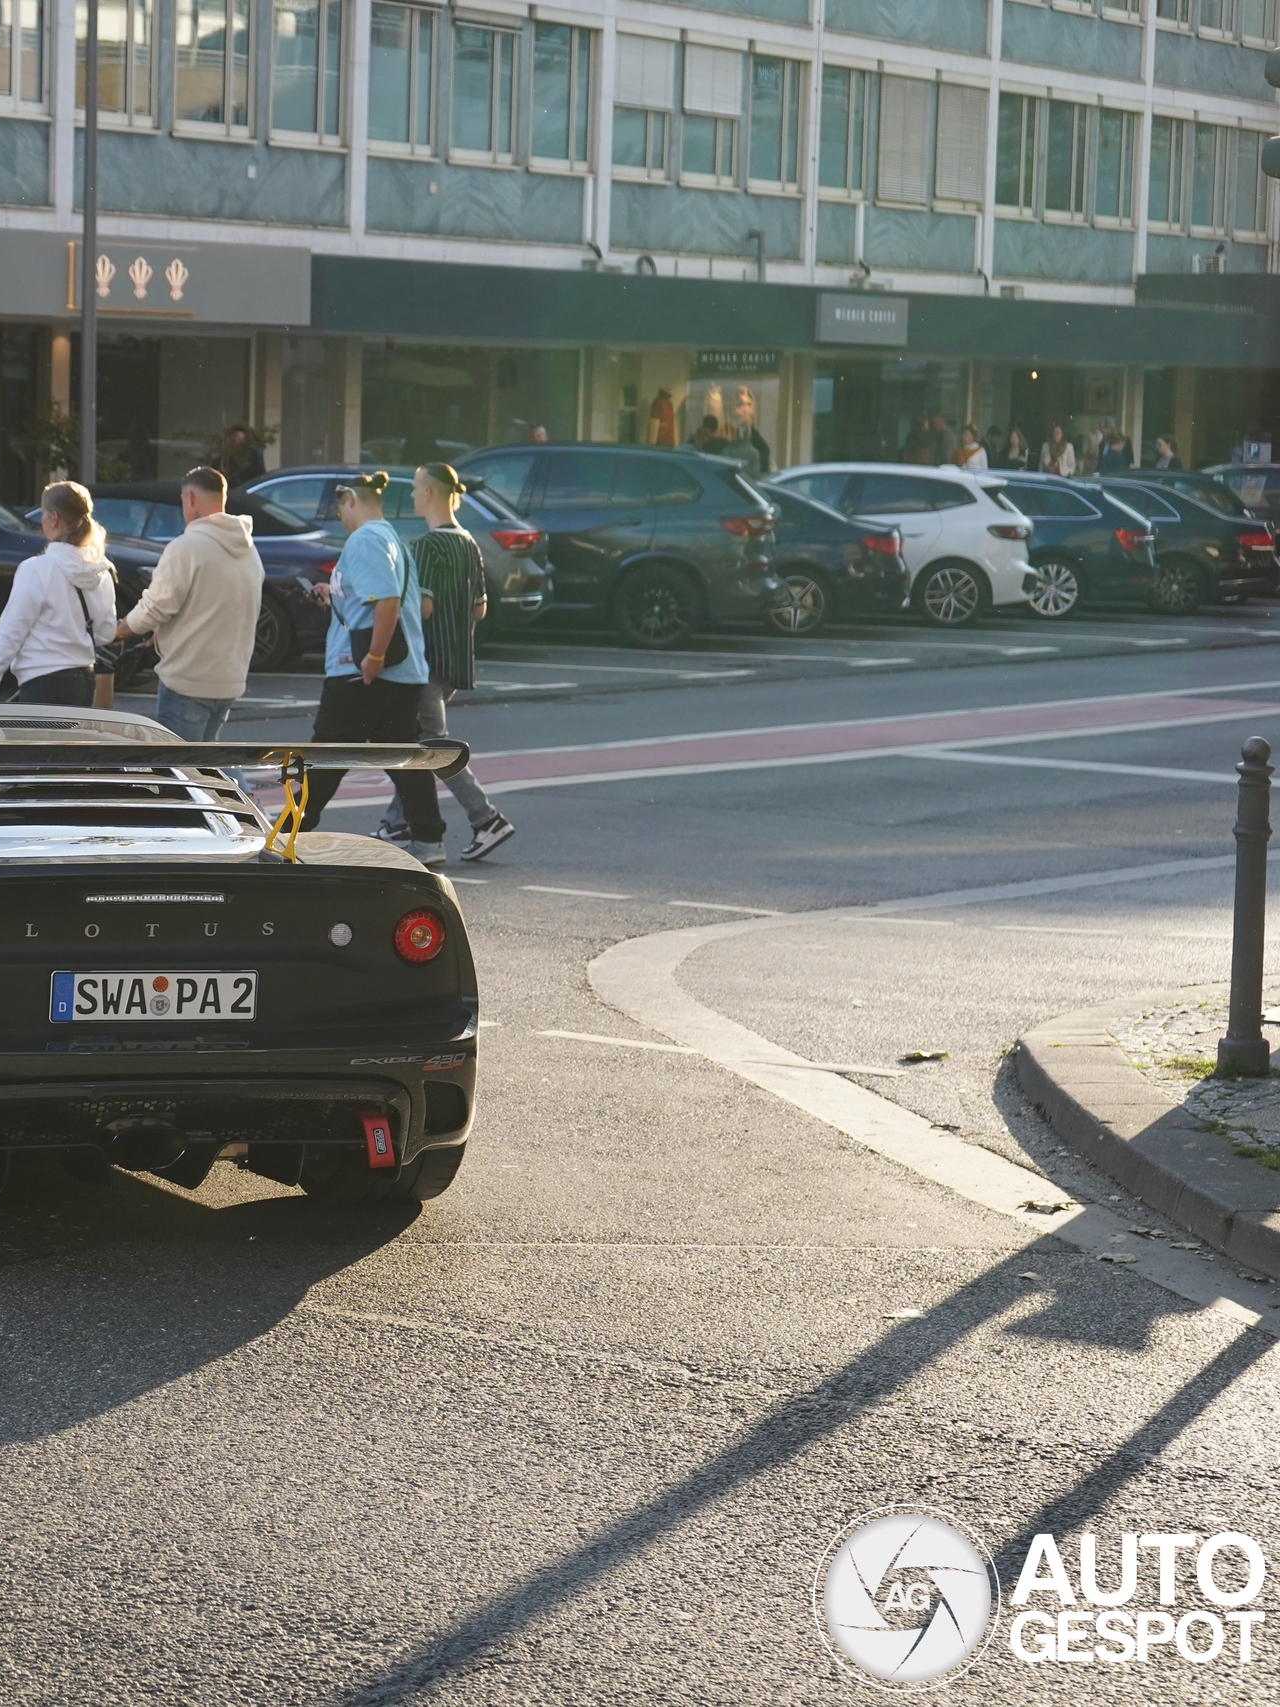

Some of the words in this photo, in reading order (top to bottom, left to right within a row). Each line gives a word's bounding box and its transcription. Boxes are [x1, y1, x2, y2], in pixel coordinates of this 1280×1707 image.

[701, 352, 737, 363] WERNER
[742, 352, 776, 363] CHRIST
[24, 922, 275, 938] LOTUS
[74, 977, 148, 1016] SWA
[175, 977, 222, 1015] PA
[230, 977, 253, 1014] 2
[58, 1001, 67, 1013] D
[349, 1055, 426, 1066] EXIGE
[425, 1052, 467, 1066] 430
